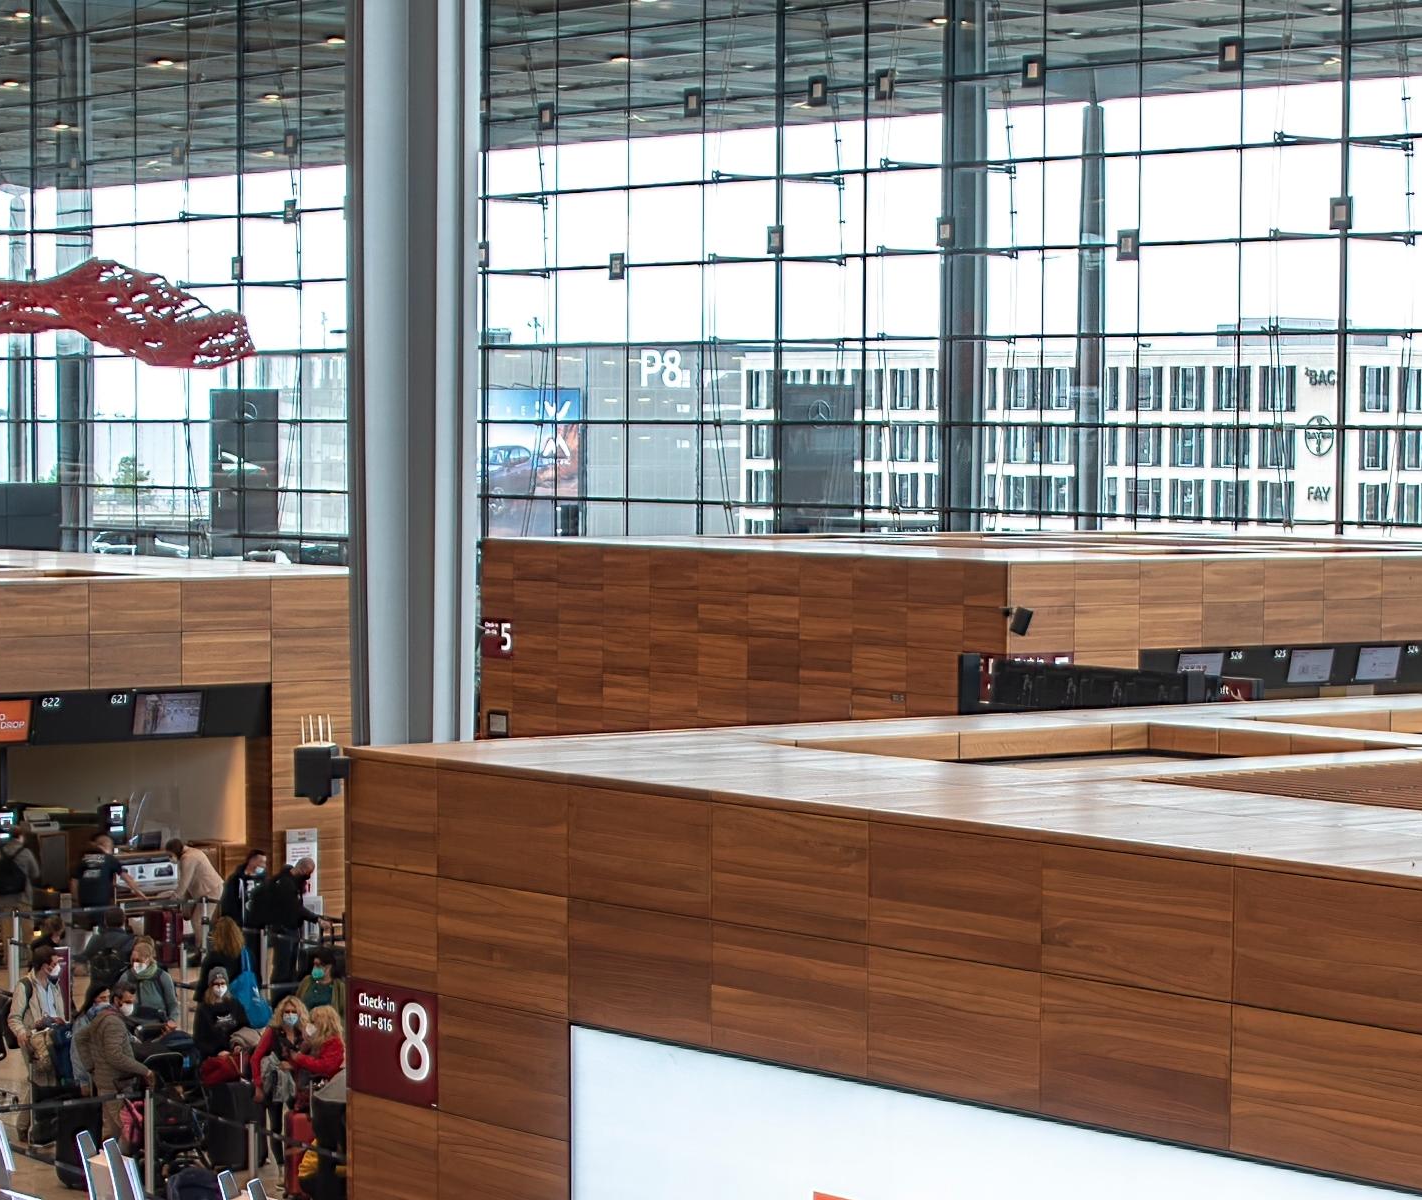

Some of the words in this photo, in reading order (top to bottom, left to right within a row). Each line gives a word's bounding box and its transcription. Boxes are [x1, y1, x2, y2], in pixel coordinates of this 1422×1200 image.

[640, 350, 683, 388] P8
[1307, 486, 1331, 502] FAY
[500, 623, 512, 651] 5
[41, 697, 62, 708] 622
[110, 694, 129, 705] 621
[0, 720, 25, 730] DROP
[358, 992, 395, 1013] Check-in
[400, 1002, 430, 1081] 8
